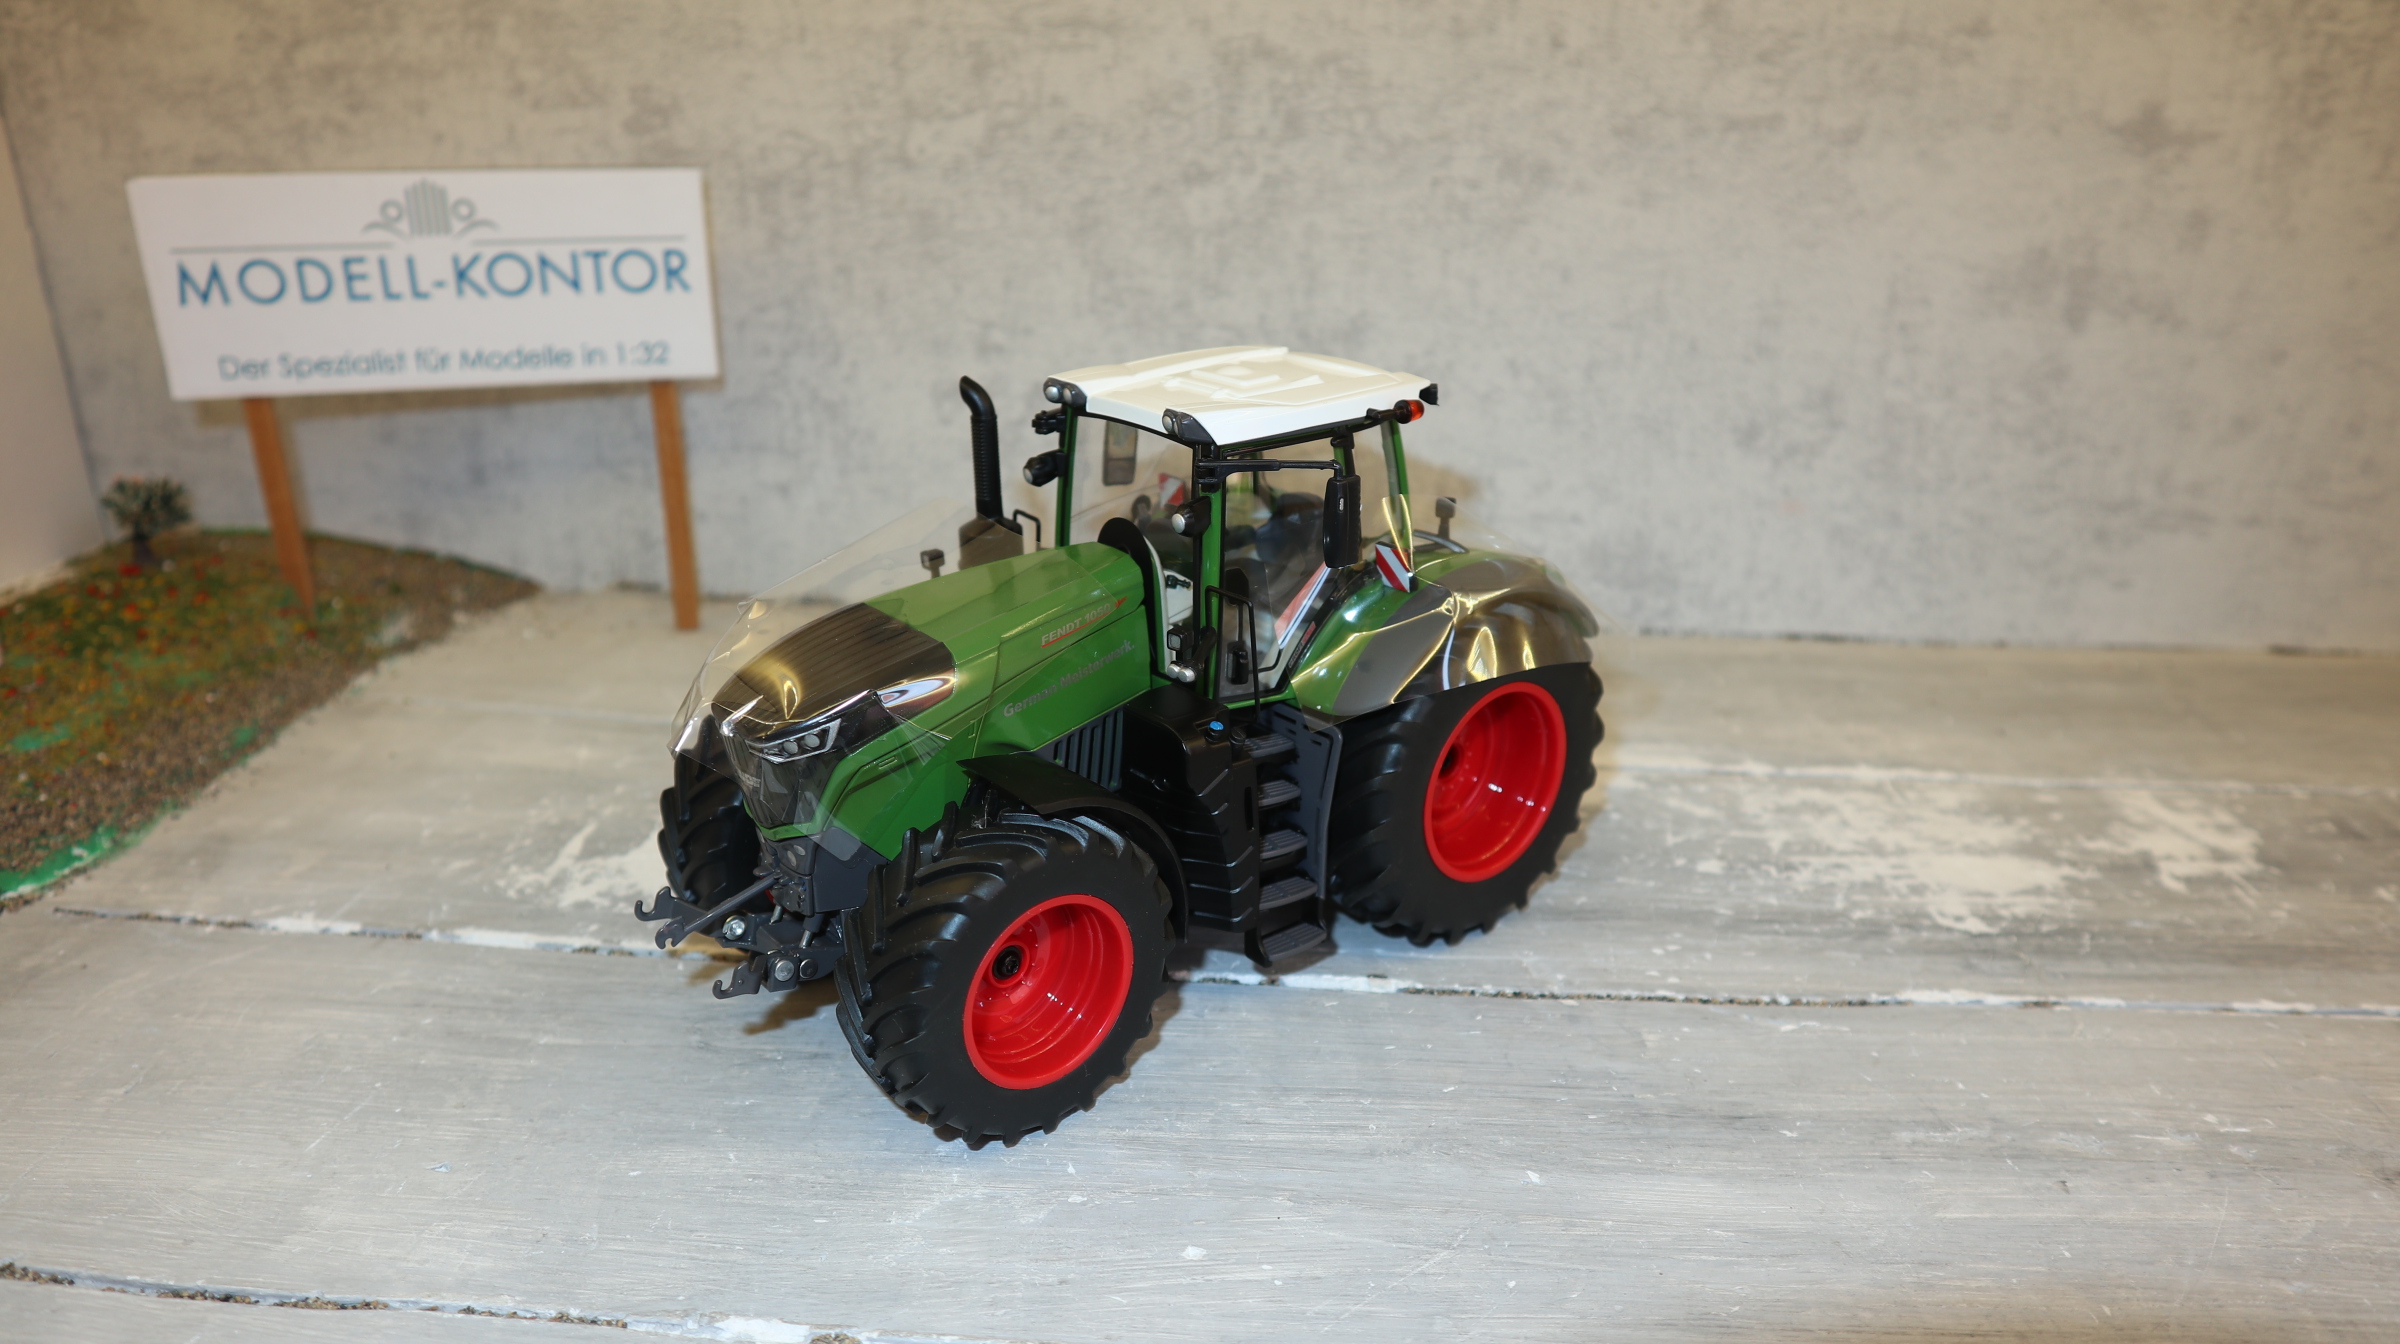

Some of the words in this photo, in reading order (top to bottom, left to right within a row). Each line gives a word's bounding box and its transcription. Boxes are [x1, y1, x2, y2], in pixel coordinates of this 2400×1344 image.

[176, 247, 692, 307] MODELL-KONTOR
[217, 353, 269, 382] Der
[277, 349, 406, 383] Spezialist
[414, 346, 451, 374] für
[459, 344, 575, 371] Modelle
[580, 340, 608, 368] in
[616, 339, 672, 367] 1:32
[1040, 617, 1083, 646] FENDT
[1084, 602, 1111, 623] 1050
[1003, 682, 1059, 718] German
[1060, 639, 1136, 688] Meisterwerk.
